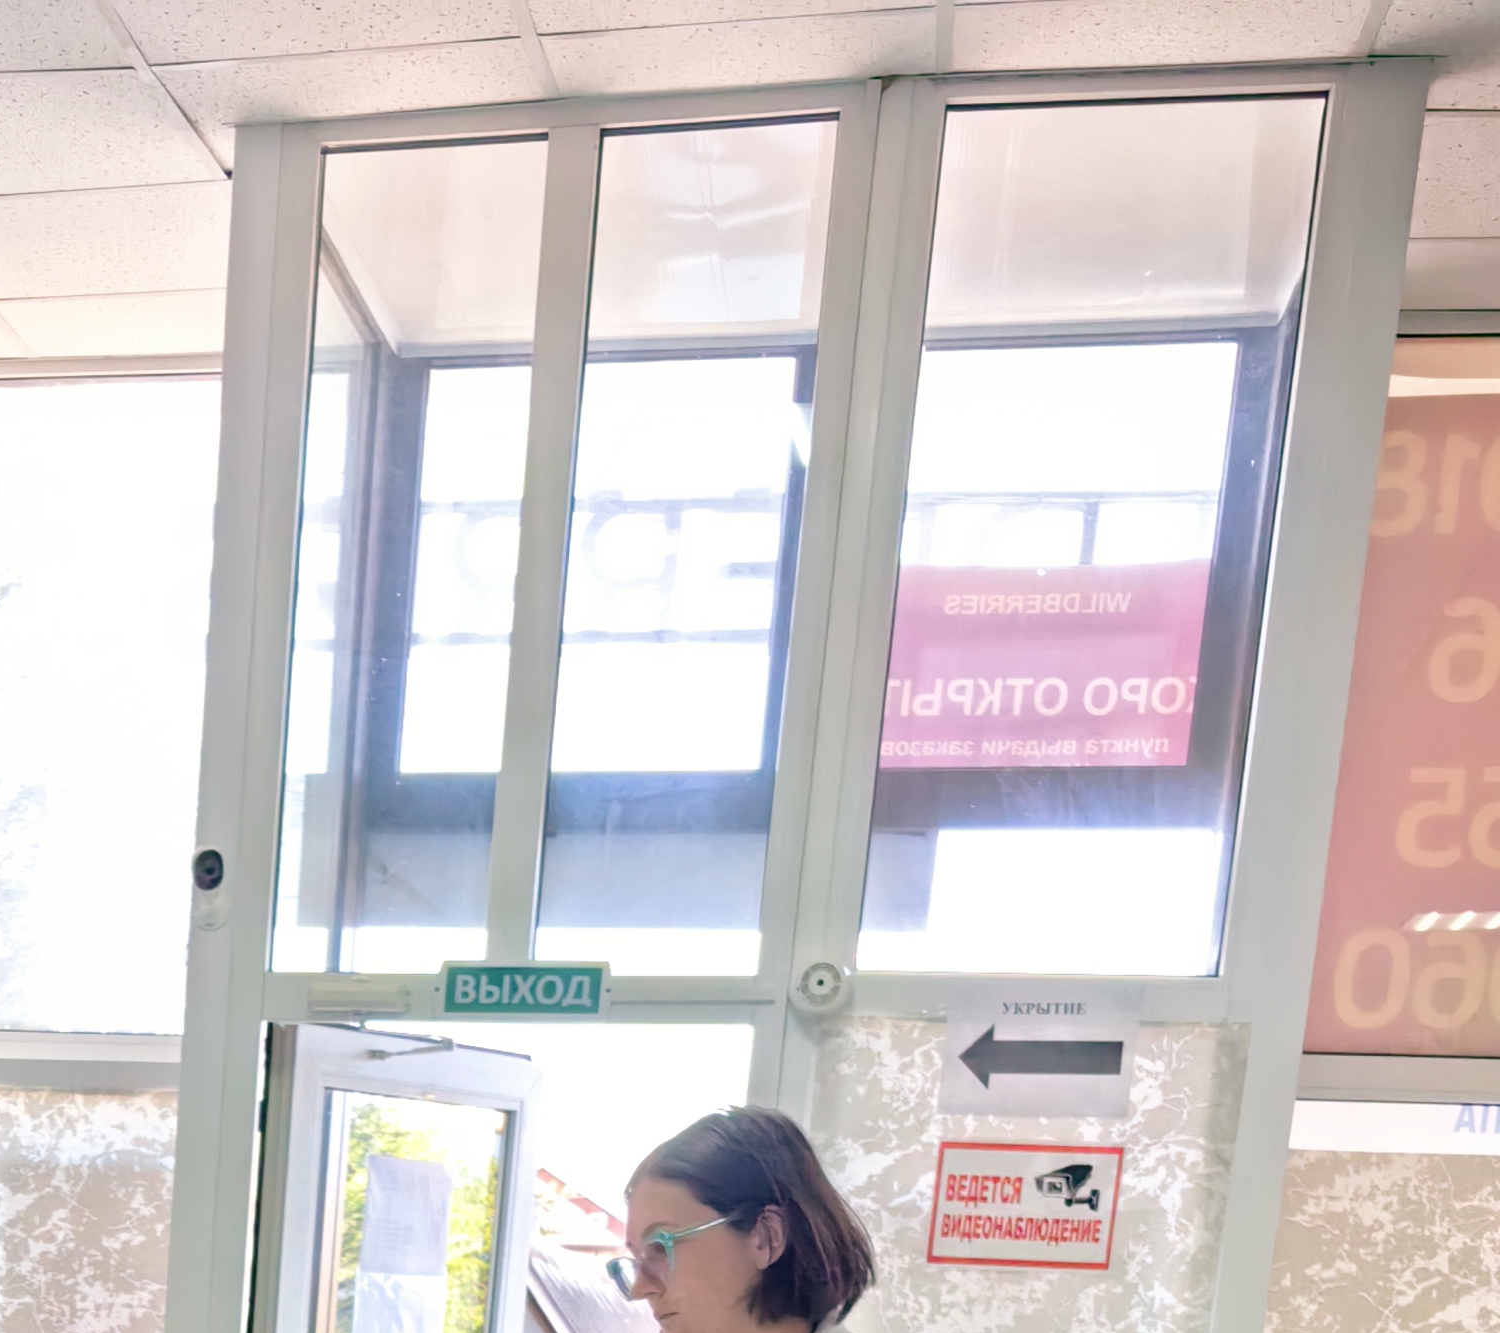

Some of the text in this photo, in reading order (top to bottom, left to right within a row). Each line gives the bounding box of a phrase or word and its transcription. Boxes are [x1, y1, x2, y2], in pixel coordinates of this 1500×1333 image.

[453, 974, 593, 1008] ВЫХОД
[1002, 1002, 1087, 1016] УКРЫТИЕ
[945, 1174, 1023, 1208] ВЕДЕТСЯ
[940, 1214, 1103, 1246] ВИДЕОНАБЛЮДЕНИЕ
